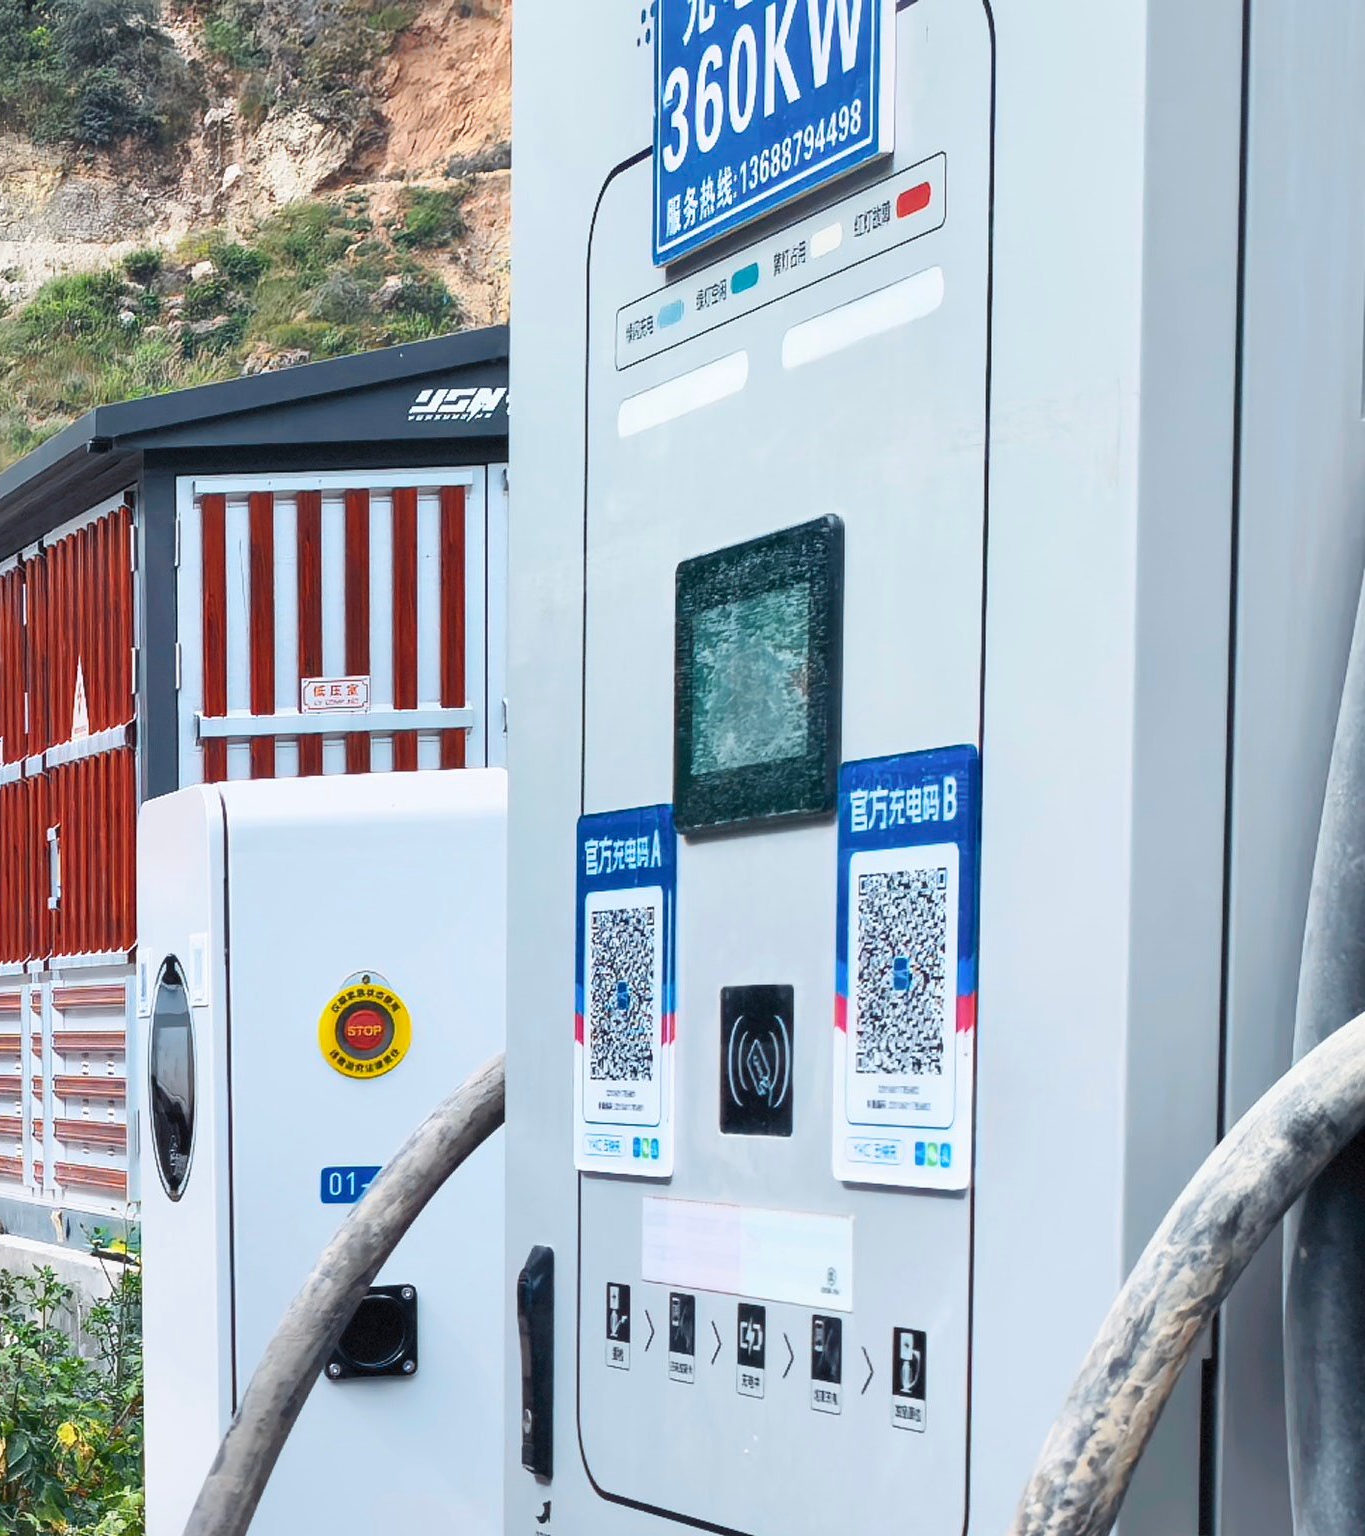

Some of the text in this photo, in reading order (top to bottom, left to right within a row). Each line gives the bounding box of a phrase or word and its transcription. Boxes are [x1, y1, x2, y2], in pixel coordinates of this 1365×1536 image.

[663, 0, 863, 173] 360KW
[666, 99, 862, 238] 服务热线:13688794498
[849, 775, 958, 834] 官方充电码B
[584, 828, 662, 876] 官方充电码A
[347, 1024, 383, 1037] STOP
